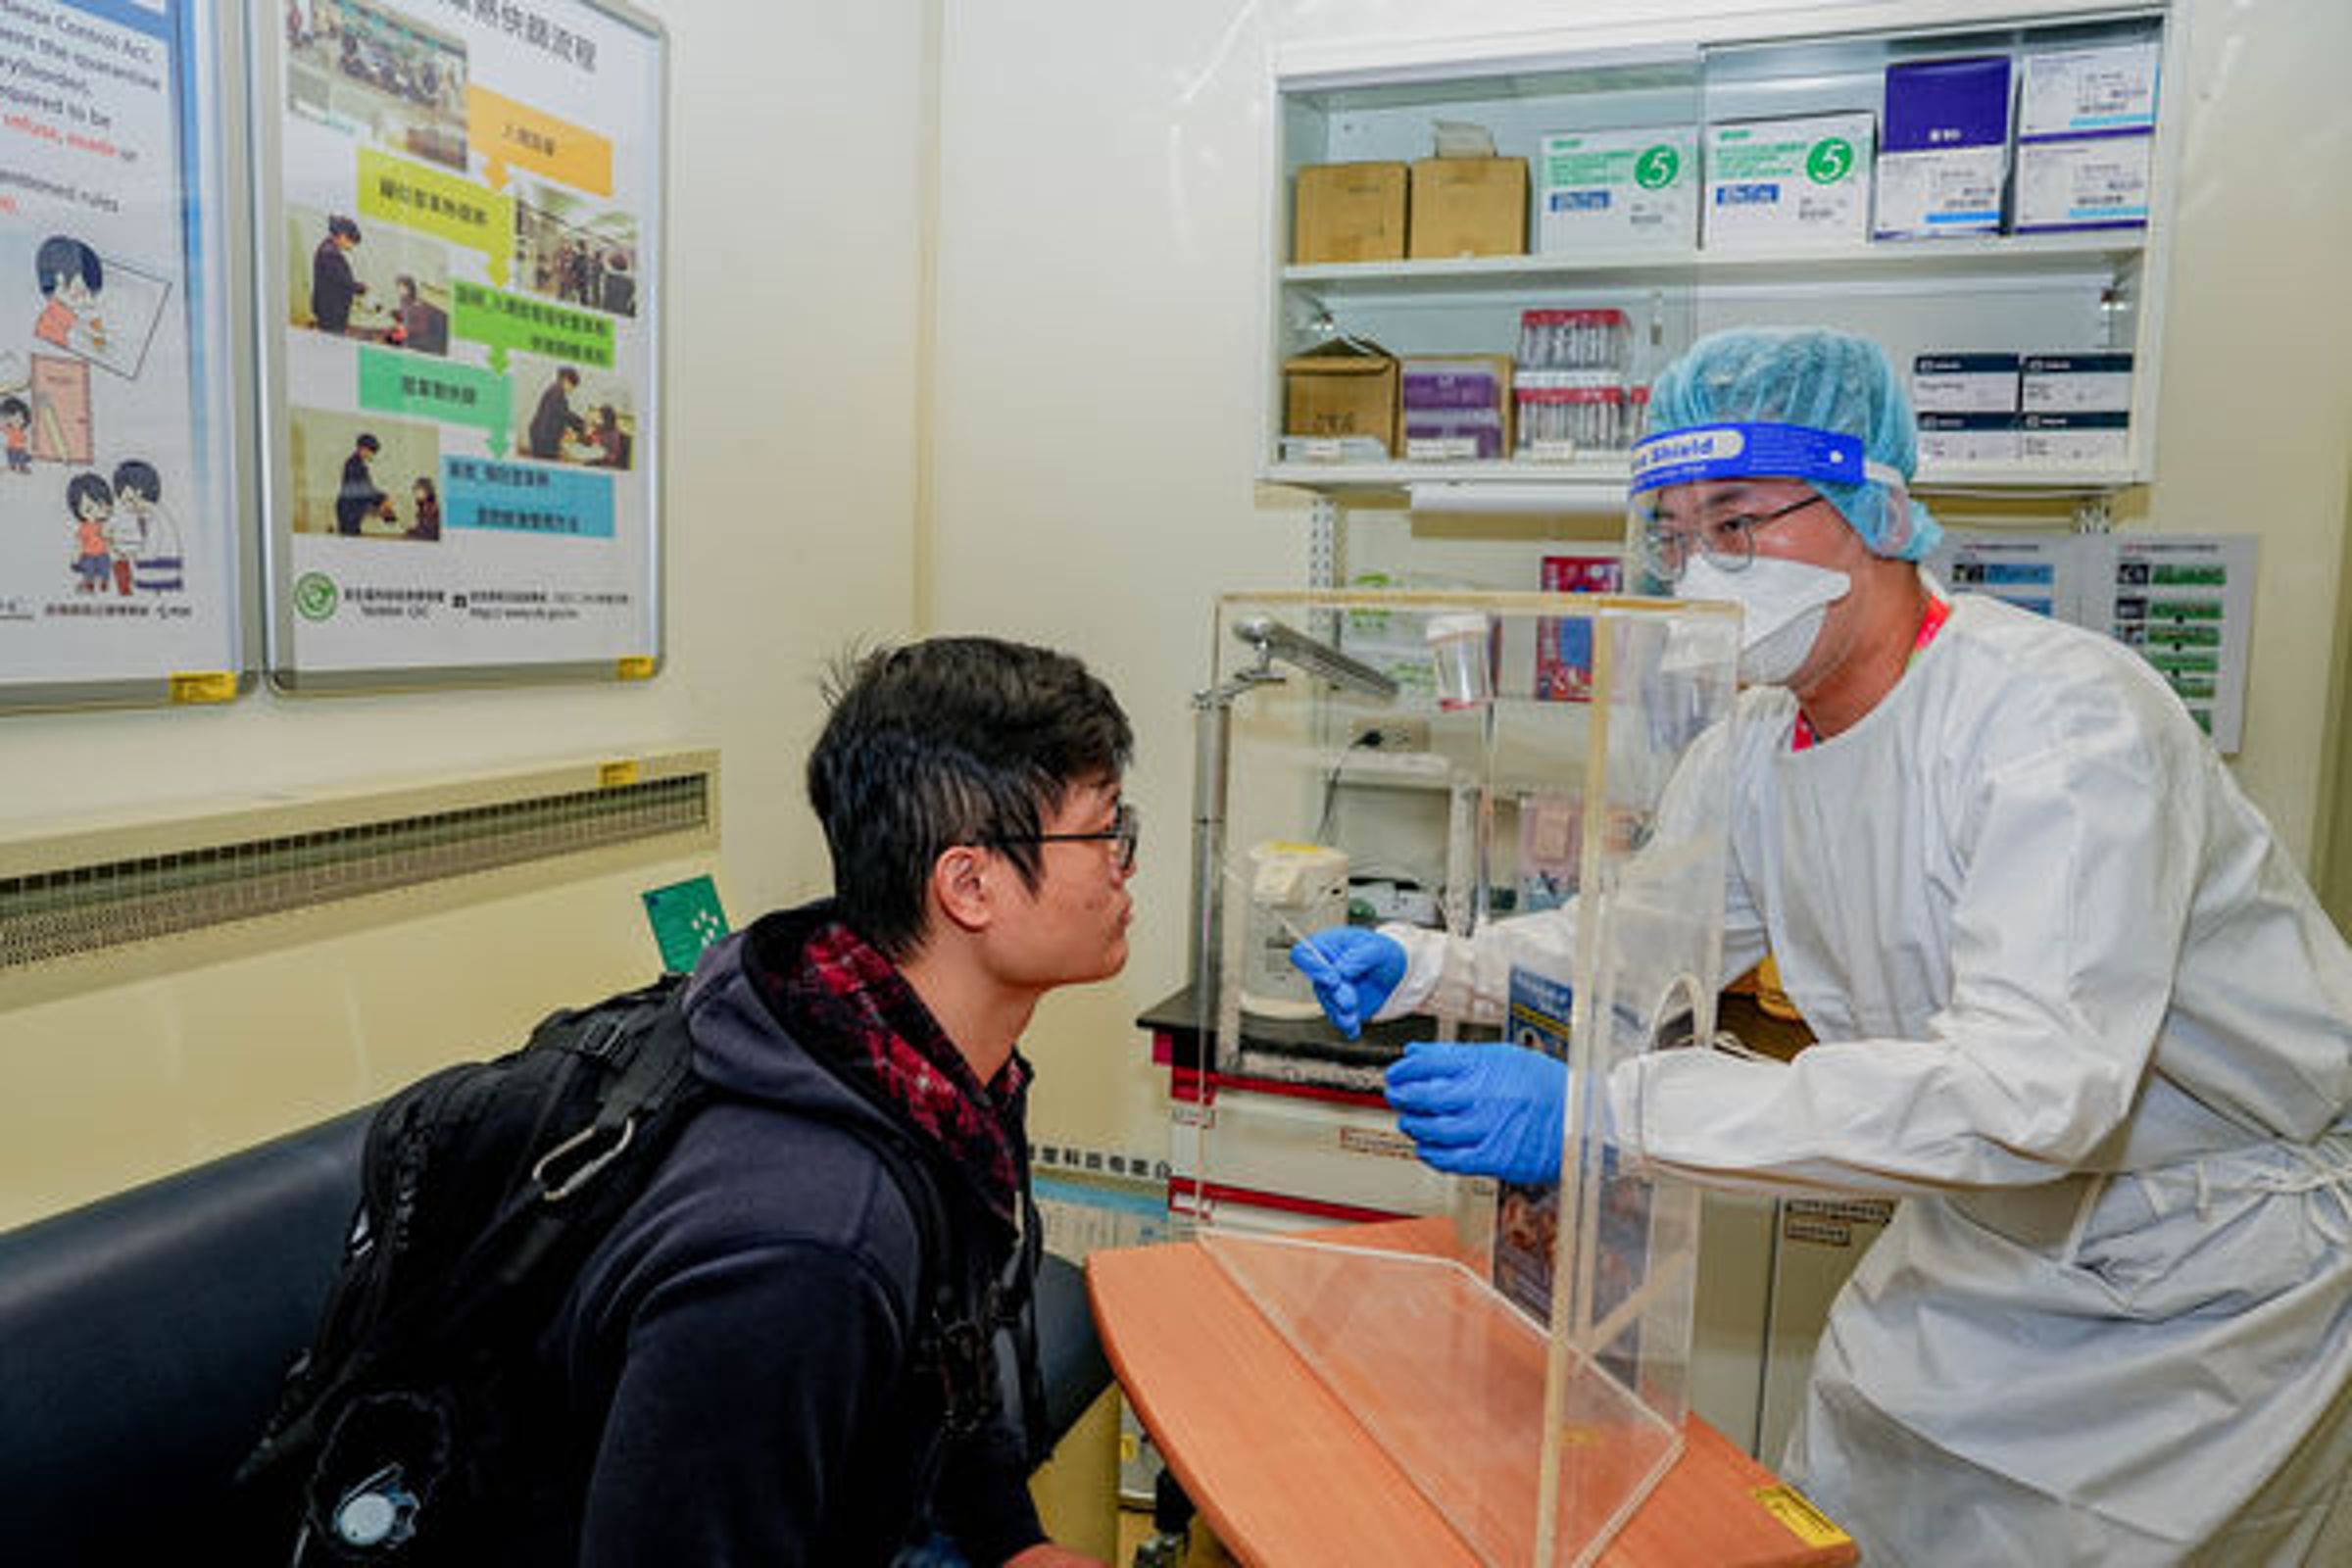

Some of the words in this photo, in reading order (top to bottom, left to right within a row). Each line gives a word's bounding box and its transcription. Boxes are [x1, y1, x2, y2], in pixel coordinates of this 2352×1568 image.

[56, 15, 118, 50] Control
[39, 37, 68, 62] the
[74, 53, 160, 90] quarantine
[68, 104, 86, 122] to
[90, 107, 111, 127] be
[1644, 150, 1670, 186] 5
[1815, 143, 1844, 181] 5
[81, 190, 119, 213] rules
[1651, 437, 1714, 464] Shield
